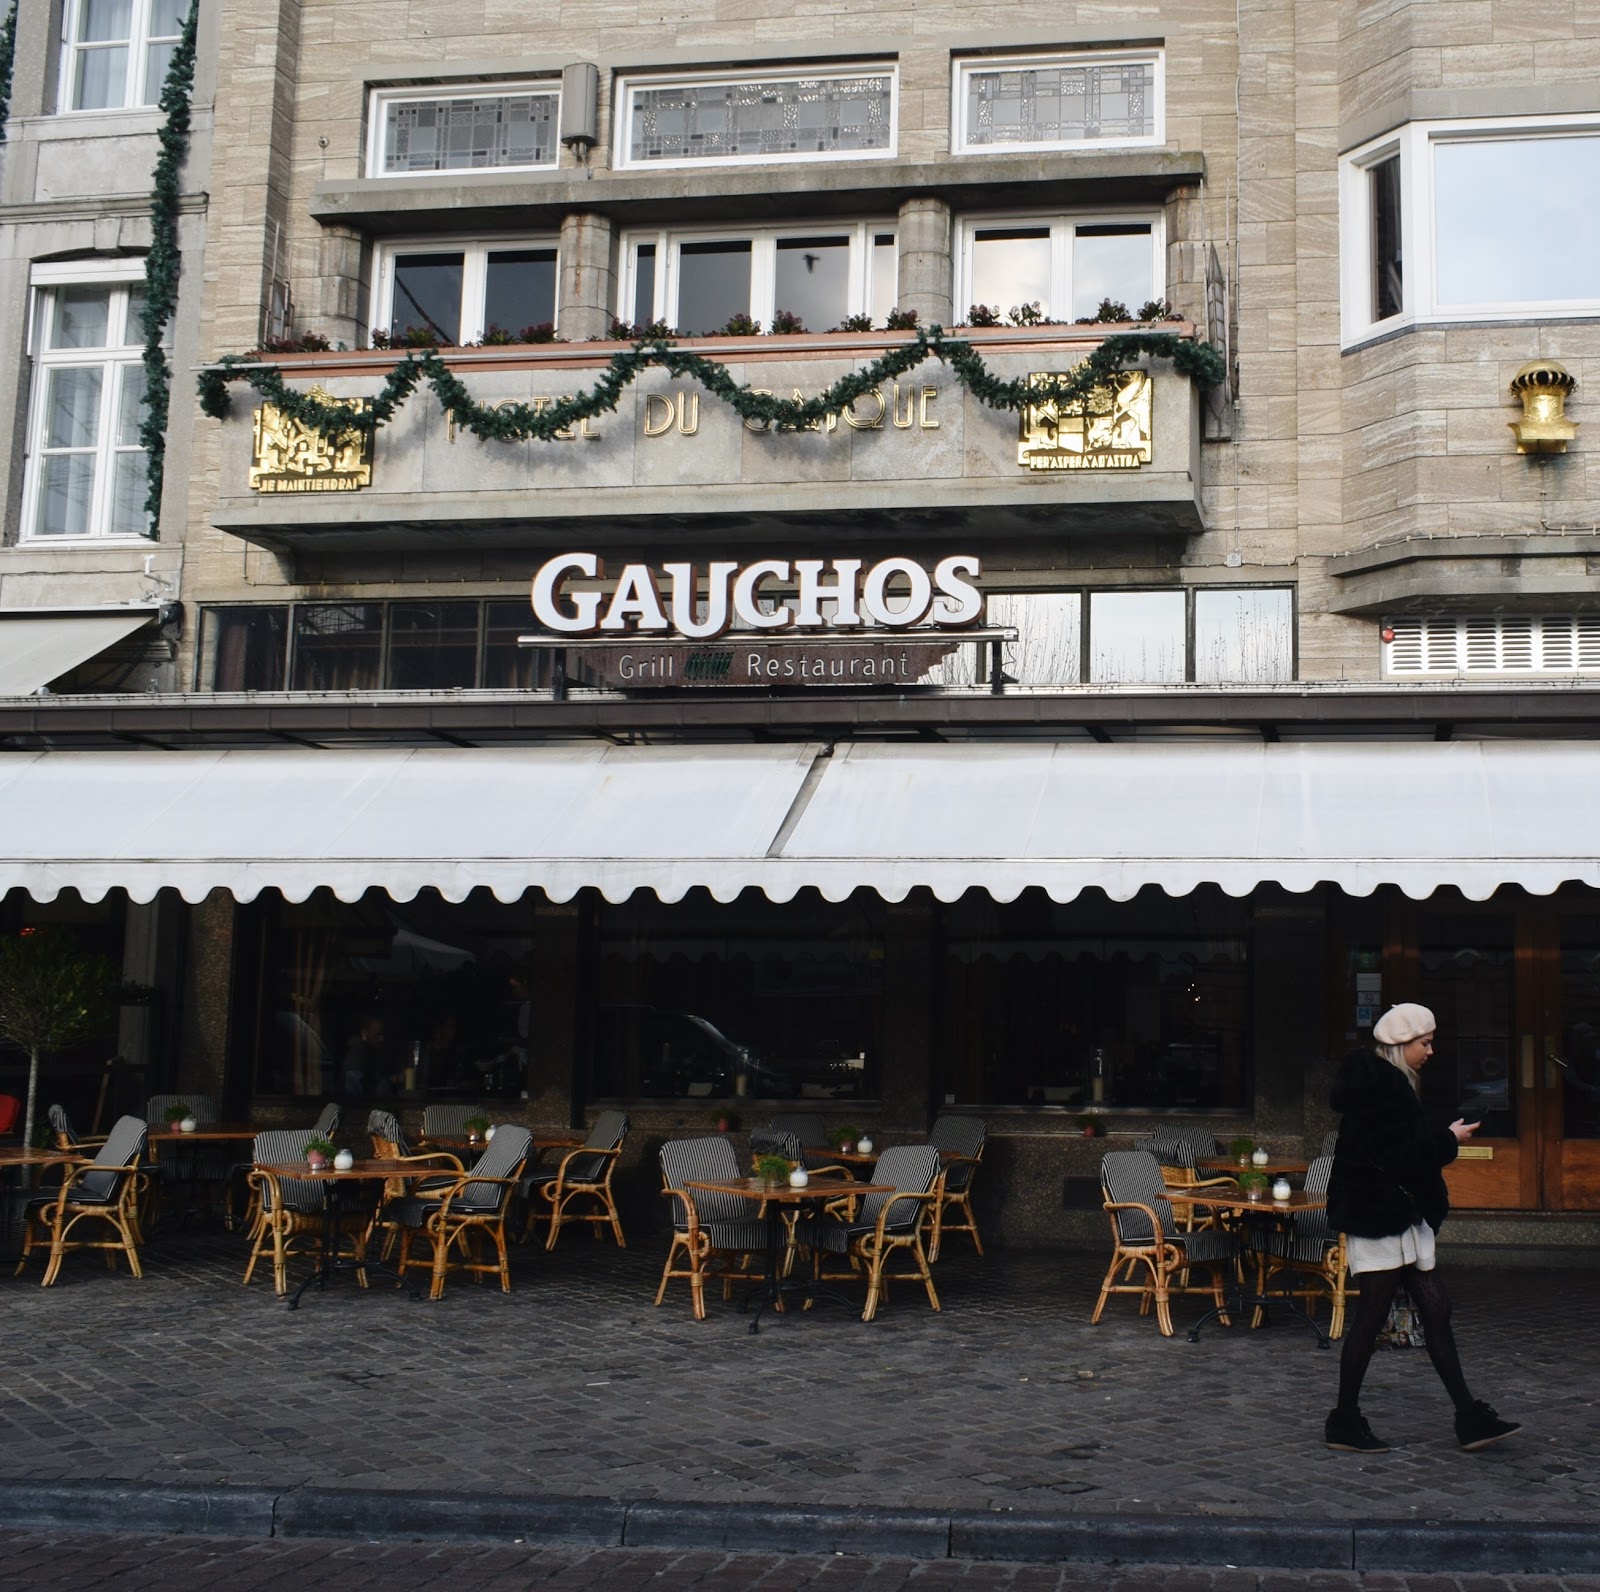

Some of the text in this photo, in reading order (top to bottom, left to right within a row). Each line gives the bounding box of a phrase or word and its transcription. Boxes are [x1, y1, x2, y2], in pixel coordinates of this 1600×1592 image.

[644, 392, 699, 435] DU
[259, 477, 358, 492] JE MAINTIENDRAI
[531, 552, 984, 638] GAUCHOS
[619, 652, 910, 679] Grill Restaurant
